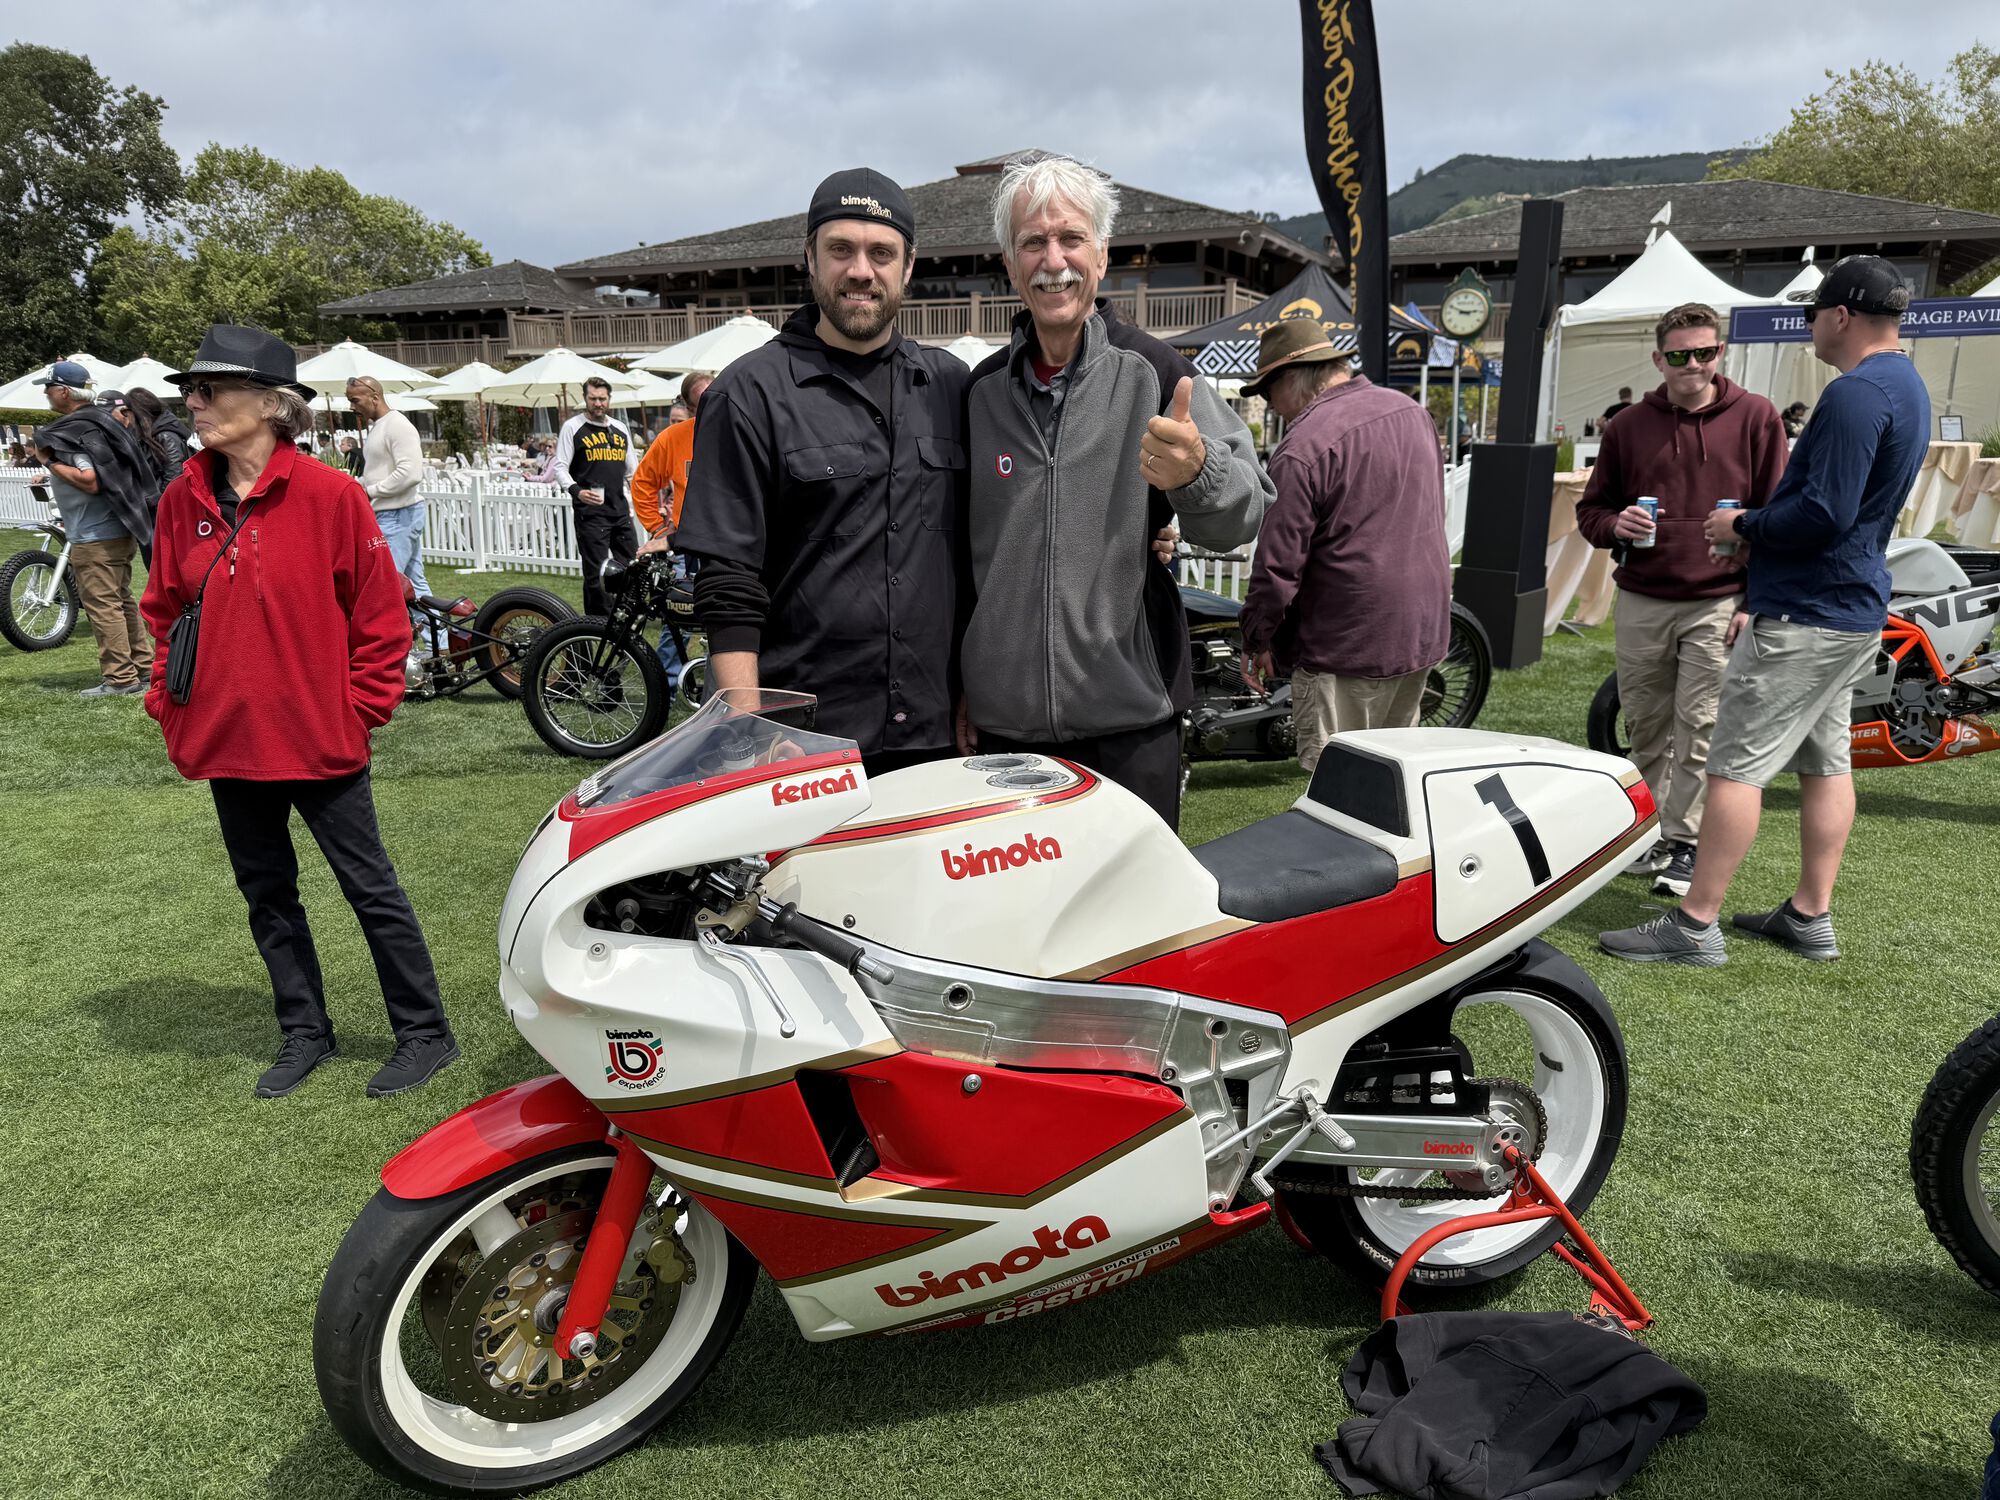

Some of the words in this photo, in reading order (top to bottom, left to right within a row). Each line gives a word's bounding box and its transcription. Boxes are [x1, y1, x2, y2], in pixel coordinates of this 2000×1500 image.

[841, 195, 878, 207] bimota
[1771, 316, 1805, 331] THE
[1899, 309, 1953, 326] ERAGE
[582, 432, 625, 448] HAREY
[1897, 584, 2000, 629] NG
[1850, 728, 1880, 740] HTER
[771, 768, 859, 807] ferrari
[1473, 772, 1552, 888] 1
[940, 832, 1062, 880] bimota
[605, 1028, 654, 1040] bimota
[618, 1066, 666, 1090] experience
[1423, 1140, 1476, 1156] bimota
[873, 1215, 1112, 1308] bimota
[1049, 1272, 1093, 1291] YAMAHA
[1410, 1267, 1466, 1280] MICHEL
